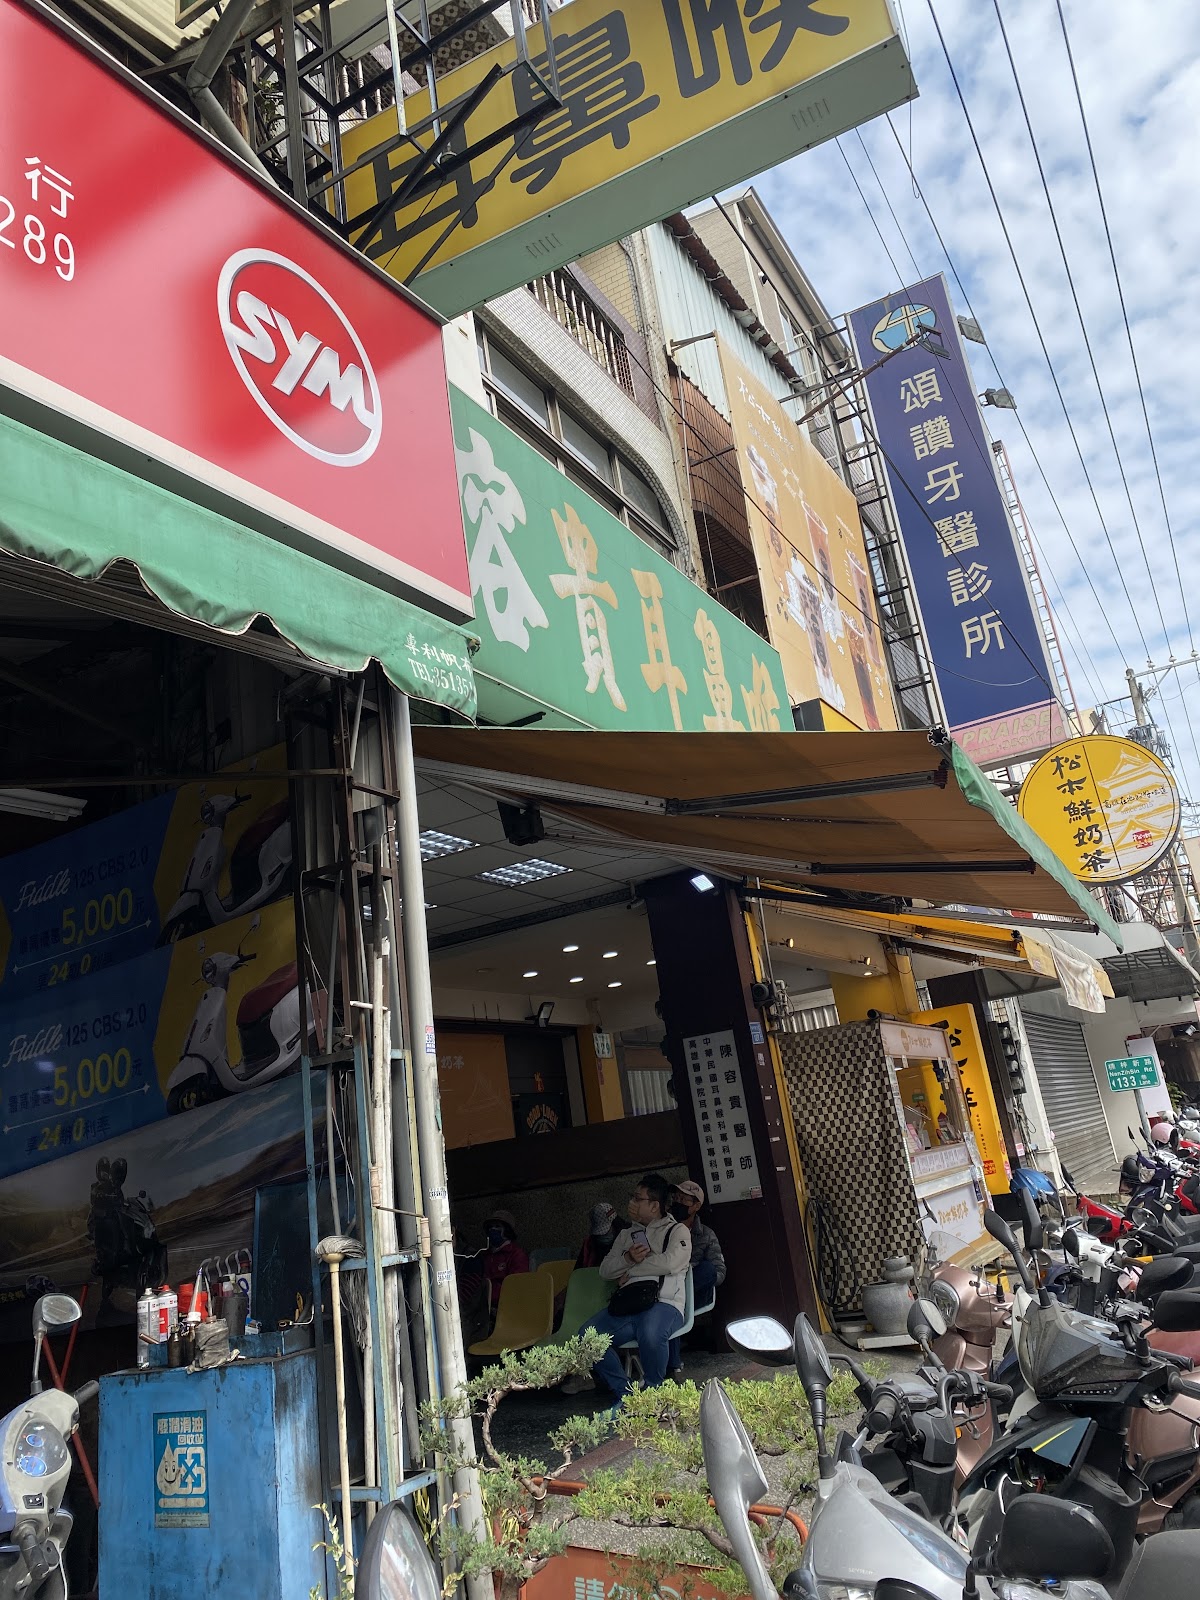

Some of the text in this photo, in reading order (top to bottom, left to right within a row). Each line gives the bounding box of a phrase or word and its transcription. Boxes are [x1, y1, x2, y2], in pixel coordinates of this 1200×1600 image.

[25, 157, 75, 218] 行
[220, 290, 376, 431] SYM
[899, 367, 1006, 660] 頌讚牙醫診所
[961, 710, 1050, 748] PRAISE
[13, 845, 149, 912] Fiddle 125 CBS 2.0
[62, 887, 133, 945] 5,000
[3, 1003, 147, 1068] Fiddle 125 CBS 2.0
[54, 1047, 132, 1106] 5,000
[702, 1037, 735, 1179] 中華民國耳鼻喉科專科醫師
[719, 1044, 753, 1170] 陳容貴醫師
[1116, 1075, 1137, 1089] 133
